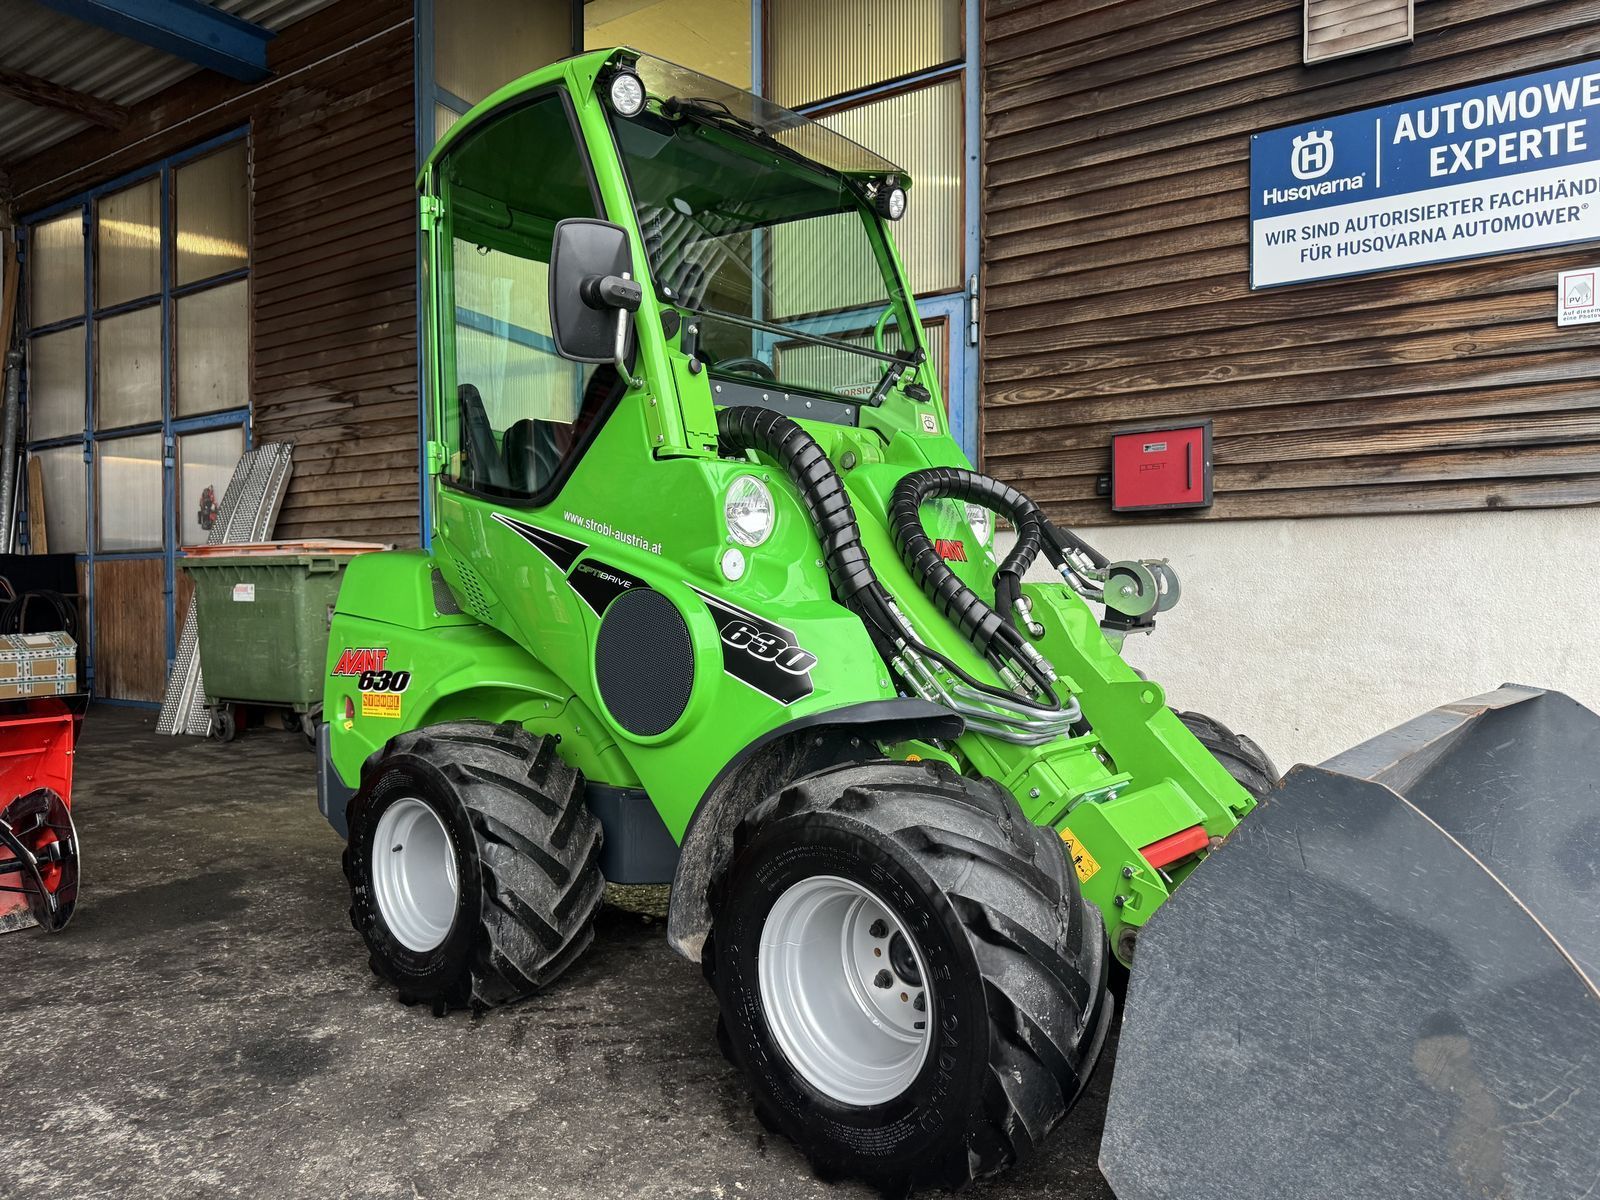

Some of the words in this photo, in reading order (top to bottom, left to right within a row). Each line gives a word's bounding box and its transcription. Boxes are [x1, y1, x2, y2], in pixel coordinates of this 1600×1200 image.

[1393, 73, 1600, 145] AUTOMOWE
[1430, 119, 1587, 177] EXPERTE
[1263, 174, 1364, 206] Husqvarna
[1265, 228, 1297, 246] WIR
[1301, 221, 1340, 241] SIND
[1344, 197, 1484, 234] AUTORISIERTER
[1489, 178, 1600, 210] FACHHÄND
[1300, 243, 1332, 263] FÜR
[1337, 226, 1447, 257] HUSQVARNA
[837, 386, 876, 396] VORSIC
[1139, 462, 1167, 472] POST
[563, 510, 662, 555] www.strobl-austria.at
[929, 538, 968, 562] VANT
[577, 563, 632, 589] OPTIDRIVE
[330, 647, 389, 676] AVANT
[720, 620, 818, 675] 630
[358, 670, 411, 693] 630
